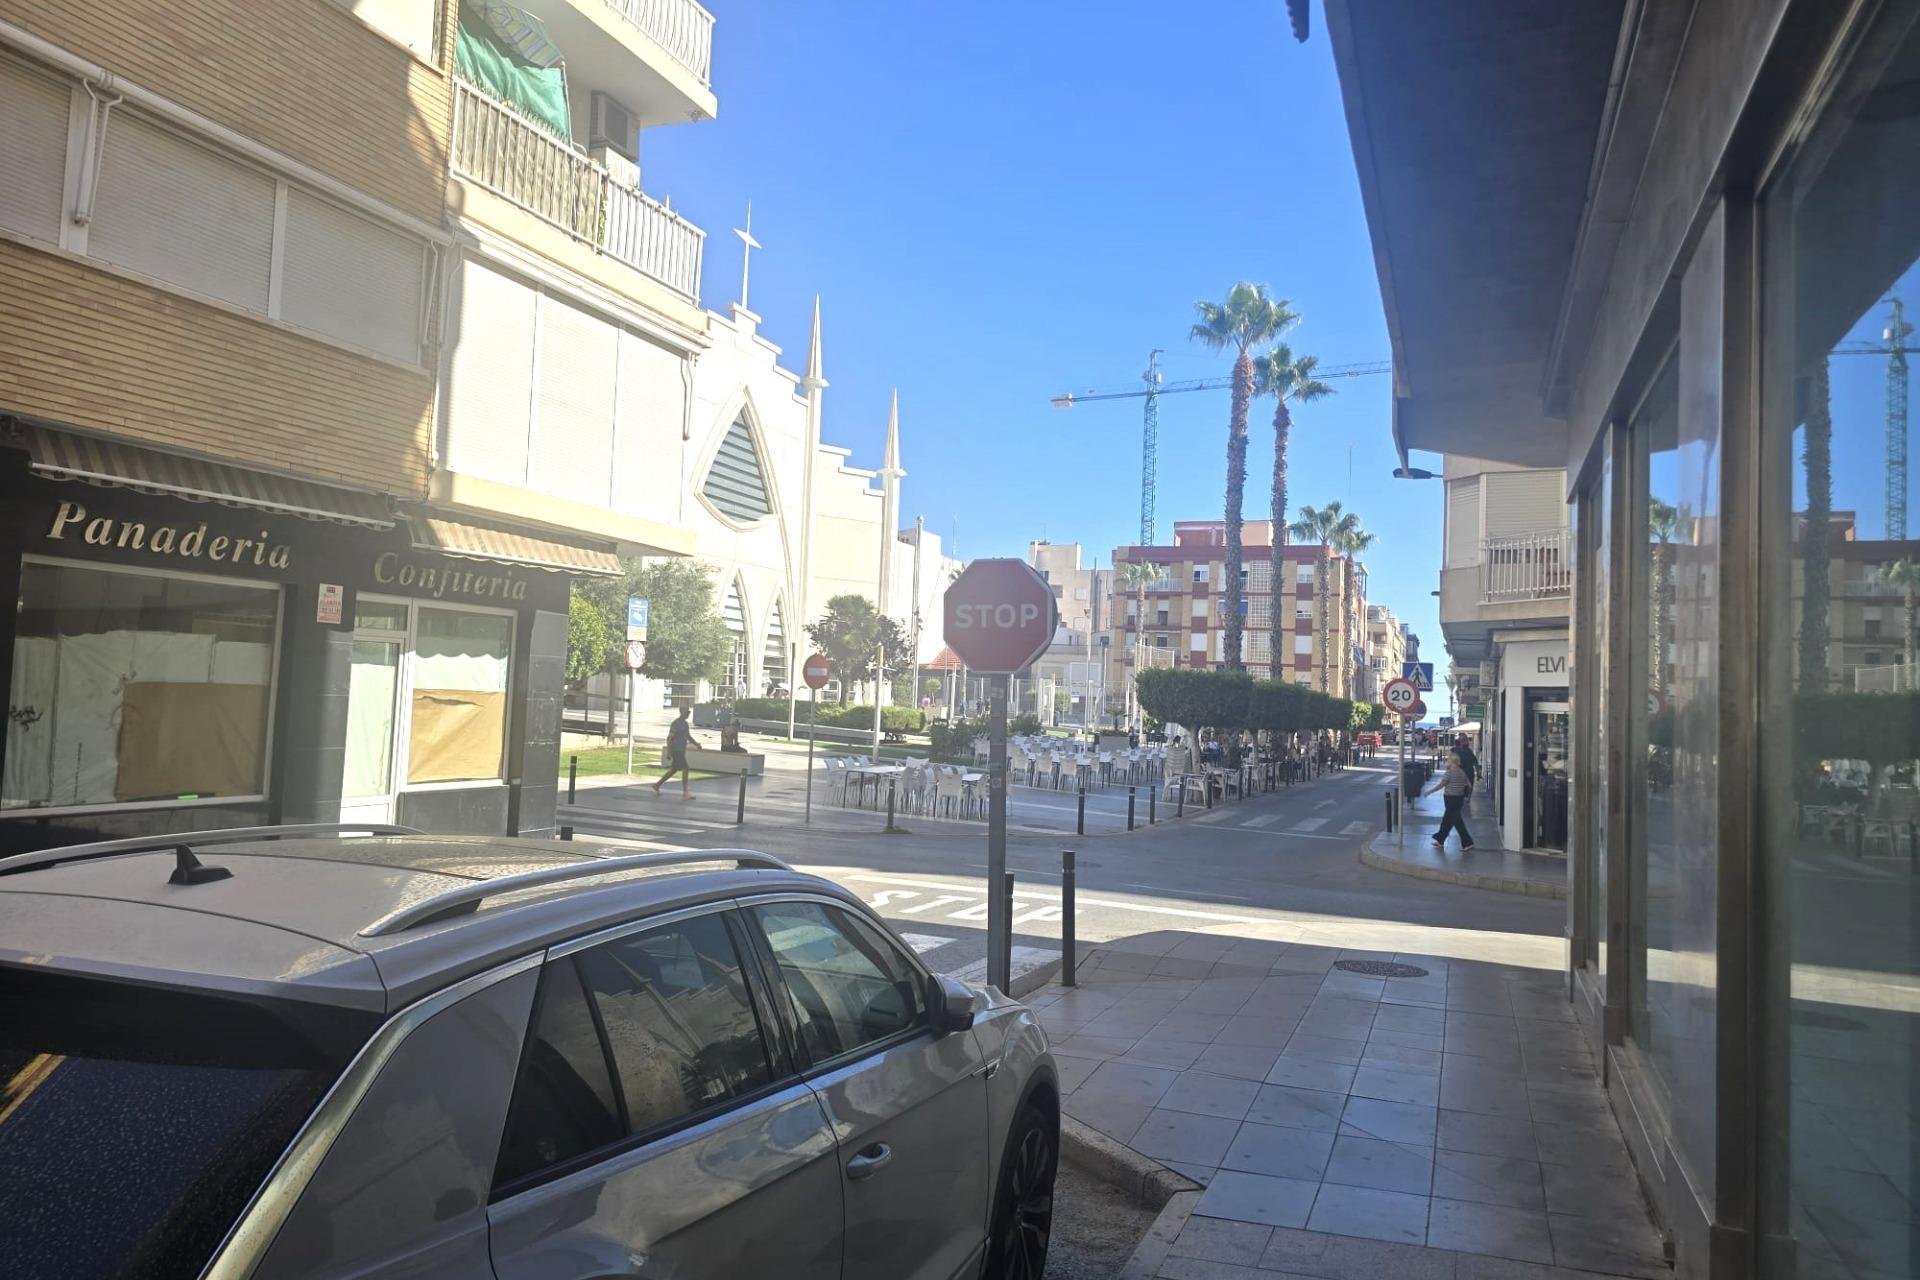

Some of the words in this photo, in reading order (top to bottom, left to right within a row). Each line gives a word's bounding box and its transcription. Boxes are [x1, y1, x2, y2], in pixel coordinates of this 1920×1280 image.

[46, 500, 290, 570] Panaderia
[374, 551, 528, 601] Confiteria
[955, 603, 1039, 628] STOP
[1391, 690, 1411, 701] 20
